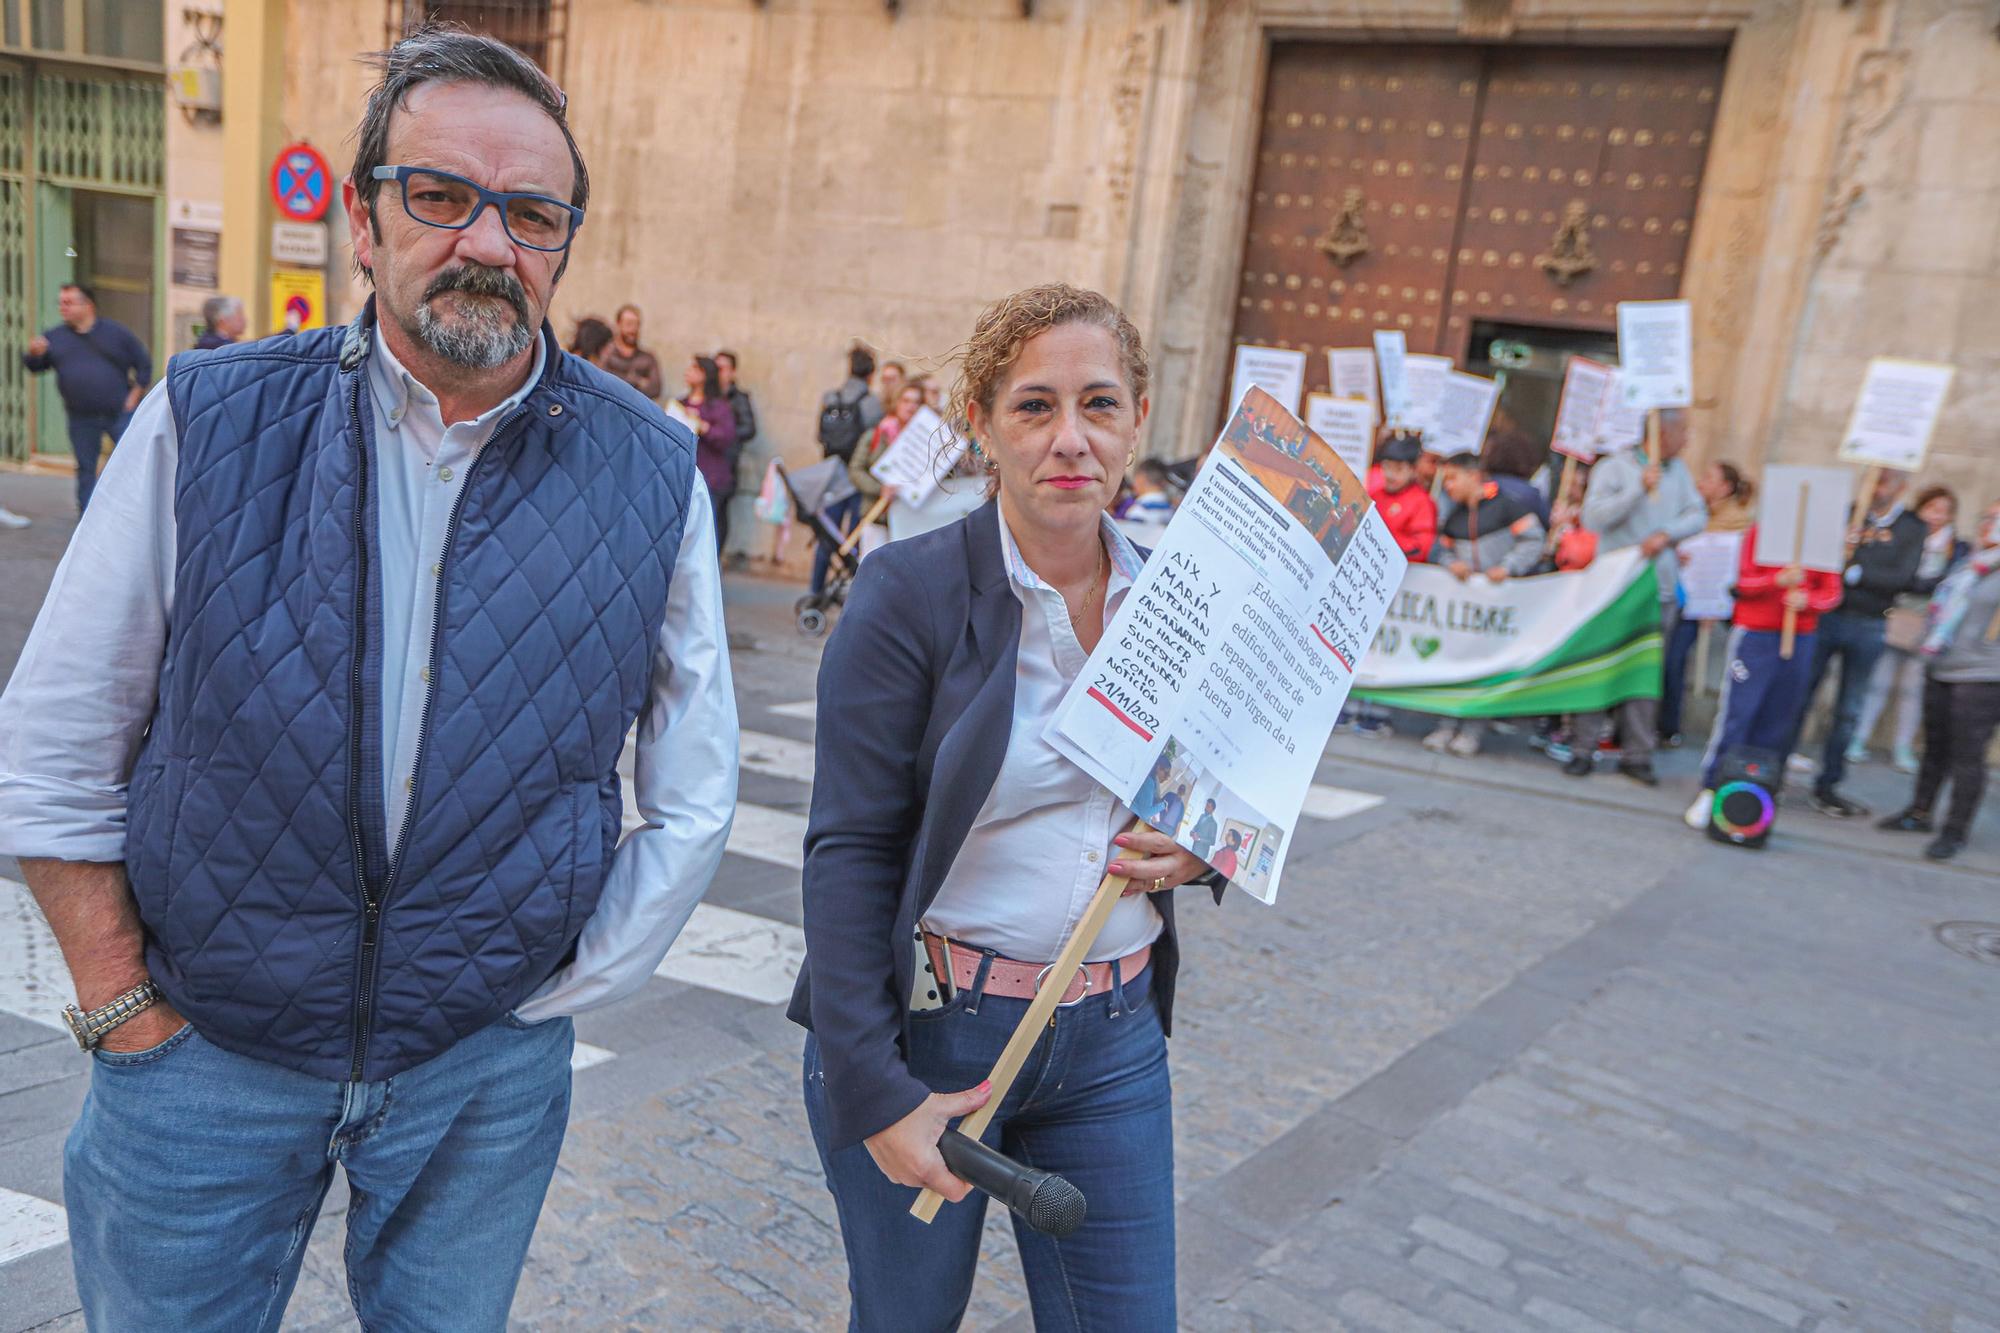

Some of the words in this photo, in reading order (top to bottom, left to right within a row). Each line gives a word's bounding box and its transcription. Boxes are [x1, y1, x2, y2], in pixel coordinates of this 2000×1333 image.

[1196, 496, 1223, 522] Puerta
[1223, 520, 1234, 531] en
[1234, 528, 1267, 561] Orihuela
[1202, 486, 1213, 498] de
[1213, 495, 1225, 508] un
[1225, 505, 1248, 528] nuevo
[1249, 525, 1276, 553] Colegio
[1277, 549, 1297, 576] Virgen
[1296, 573, 1304, 584] de
[1209, 474, 1257, 519] Unanimidad
[1253, 516, 1270, 534] por
[1269, 526, 1277, 538] la
[1277, 536, 1314, 580] construcción
[1362, 518, 1388, 564] Ramón
[1160, 566, 1209, 617] MARÍA
[1209, 582, 1221, 598] Y
[1370, 558, 1384, 581] una
[1138, 595, 1206, 655] ENGAÑARNOS
[1151, 578, 1209, 637] INTENTAN
[1252, 581, 1299, 640] Educación
[1297, 635, 1323, 669] aboga
[1319, 663, 1339, 685] por
[1360, 614, 1369, 633] la
[1120, 637, 1132, 651] LO
[1136, 651, 1180, 693] VENDEN
[1122, 657, 1155, 687] COMO
[1156, 627, 1191, 663] HACER
[1232, 623, 1268, 663] edificio
[1266, 660, 1278, 677] en
[1277, 672, 1293, 694] vez
[1291, 688, 1304, 706] de
[1242, 604, 1287, 653] construir
[1283, 648, 1295, 667] un
[1294, 662, 1322, 696] nuevo
[1094, 674, 1160, 733] 21/11/2022
[1198, 678, 1232, 719] Puerta
[1210, 662, 1245, 701] colegio
[1244, 693, 1272, 732] Virgen
[1272, 726, 1285, 744] de
[1284, 736, 1295, 755] la
[1220, 641, 1258, 683] reparar
[1256, 679, 1268, 694] el
[1263, 688, 1294, 723] actual
